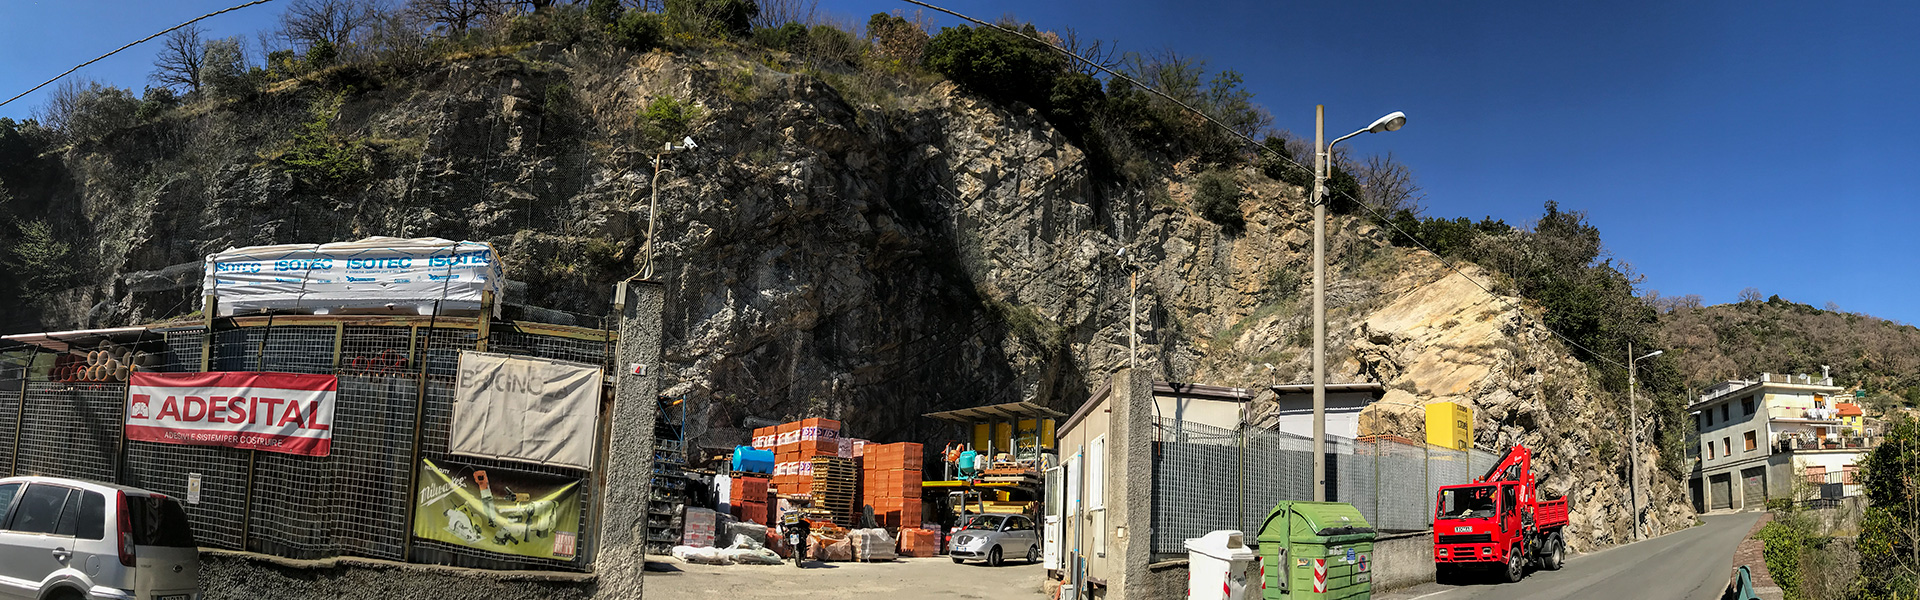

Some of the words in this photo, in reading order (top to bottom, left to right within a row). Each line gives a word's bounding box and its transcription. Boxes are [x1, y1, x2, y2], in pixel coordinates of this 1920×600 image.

[273, 258, 333, 271] ISOTEC
[346, 256, 412, 269] ISOTEC
[428, 249, 492, 267] ISOTEC
[156, 396, 330, 431] ADESITAL
[164, 431, 190, 440] ADESIVI
[196, 433, 222, 442] SISTEMI
[223, 434, 239, 443] PER
[239, 435, 283, 448] COSTRUIRE
